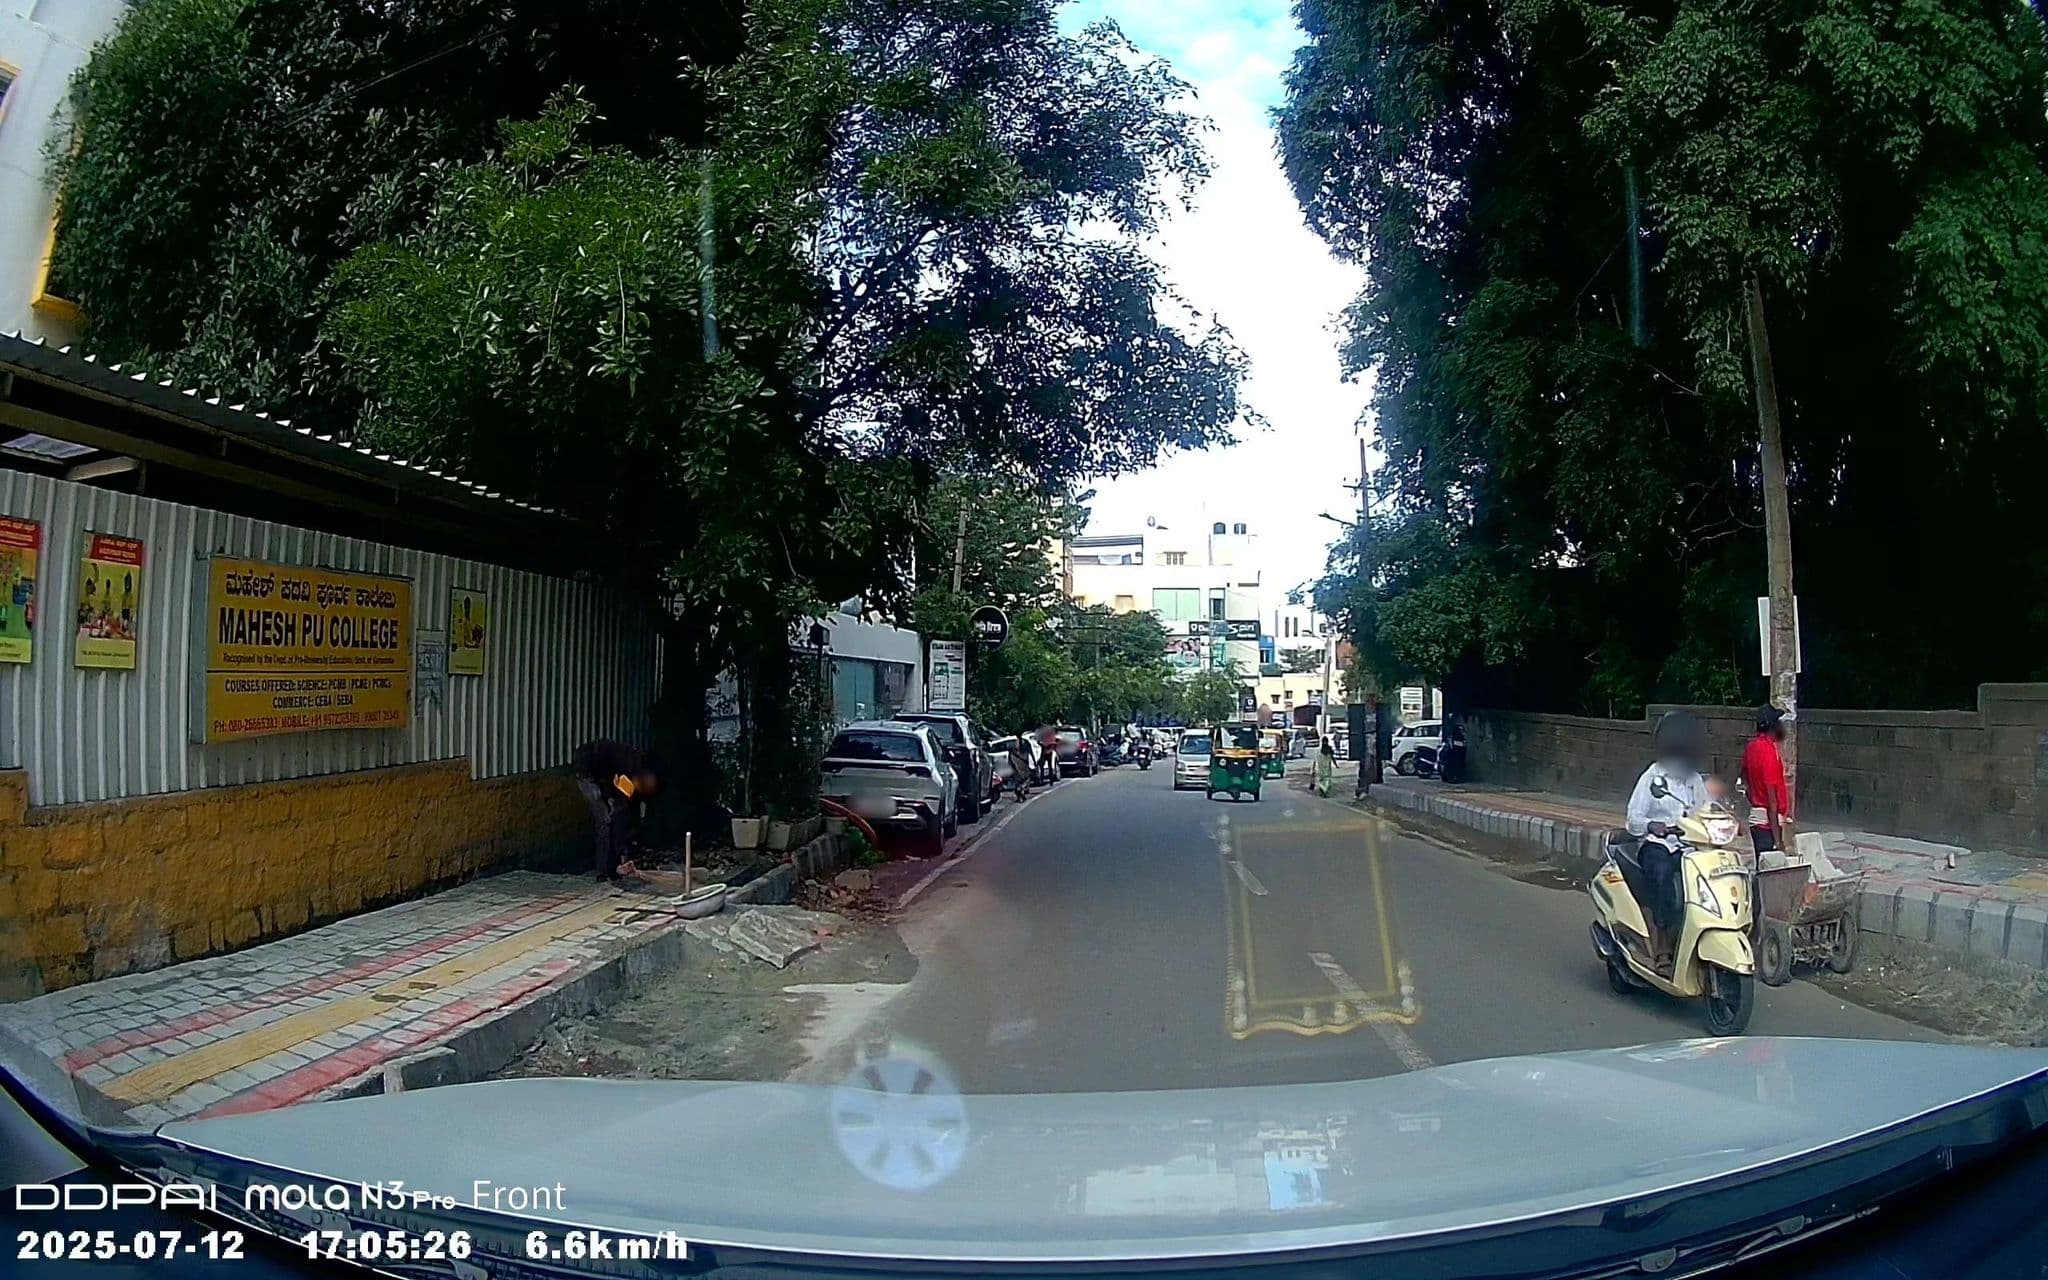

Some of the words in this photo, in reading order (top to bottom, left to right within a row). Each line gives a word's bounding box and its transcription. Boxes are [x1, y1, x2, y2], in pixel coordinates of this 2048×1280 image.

[226, 569, 276, 598] ಮಹೇಶ್
[281, 576, 311, 602] ಪದವಿ
[218, 606, 297, 647] MAHESH
[301, 613, 325, 648] PU
[329, 615, 399, 650] COLLEGE
[225, 679, 260, 693] COURSES
[272, 696, 314, 709] COMMERCE:
